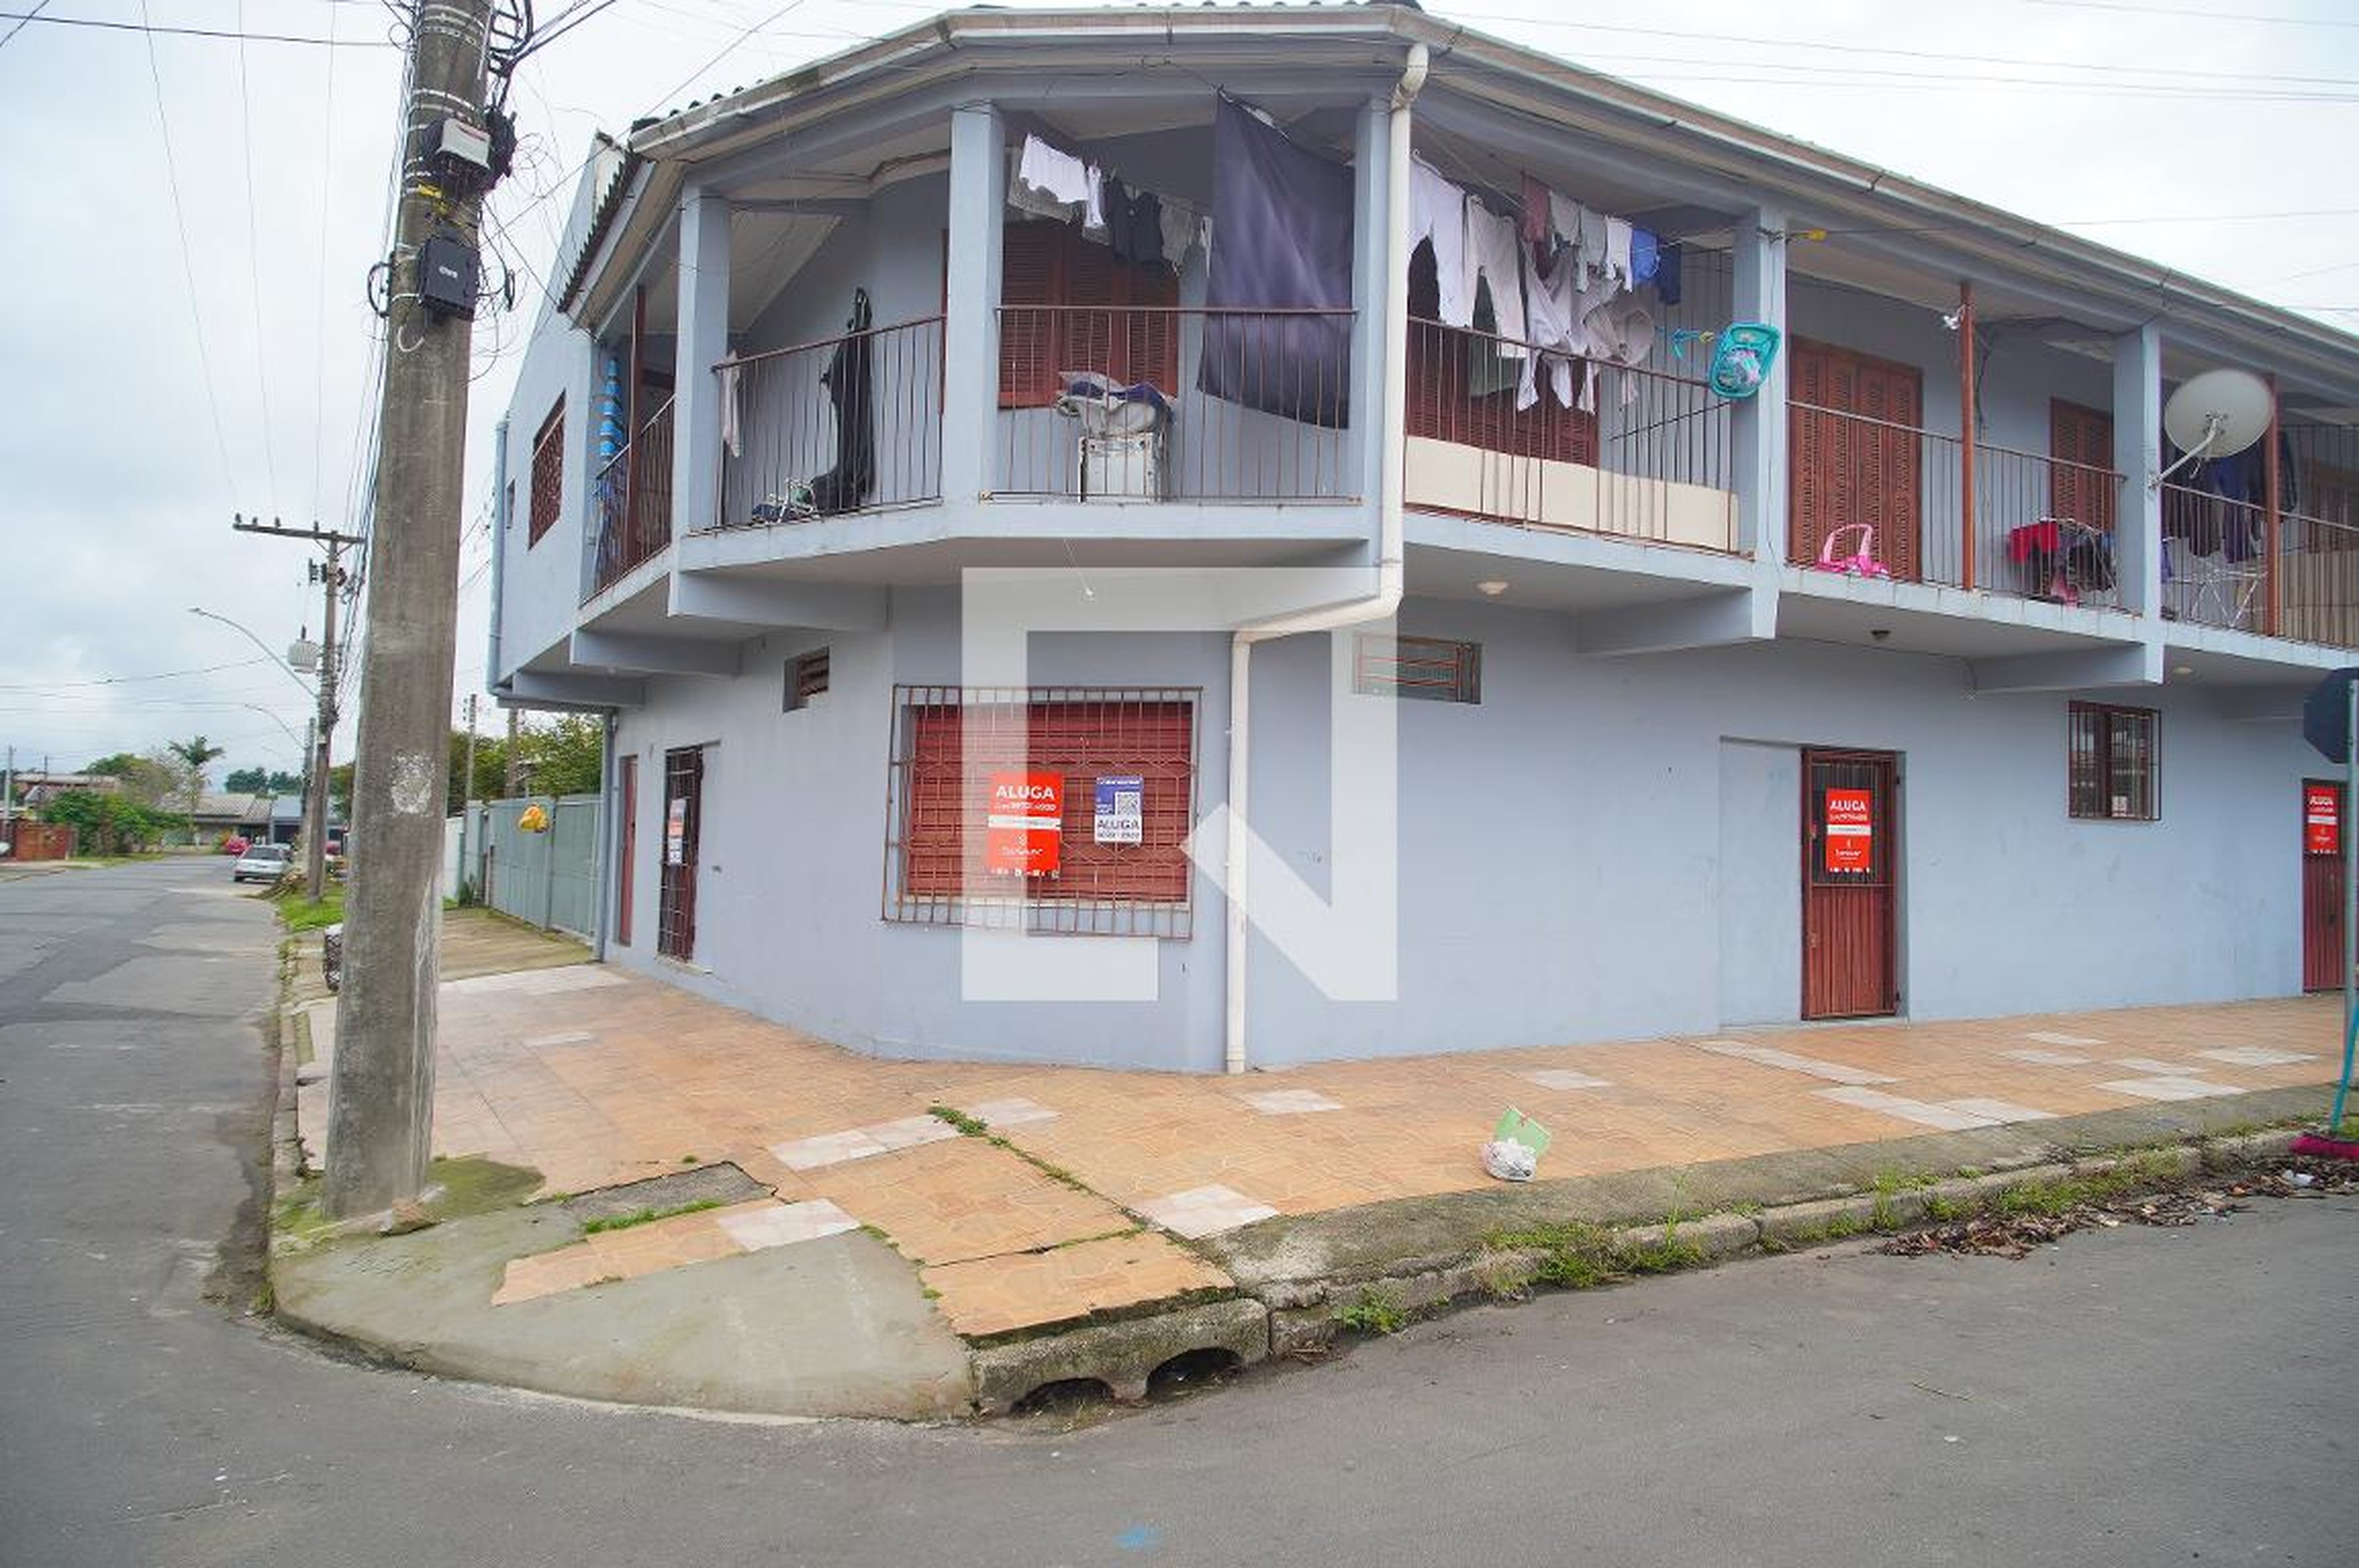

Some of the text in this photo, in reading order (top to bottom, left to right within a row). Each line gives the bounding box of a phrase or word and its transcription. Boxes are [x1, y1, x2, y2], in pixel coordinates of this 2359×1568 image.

[996, 785, 1055, 800] ALUGA
[1829, 800, 1866, 811] ALUGA
[1098, 819, 1140, 830] ALUGA
